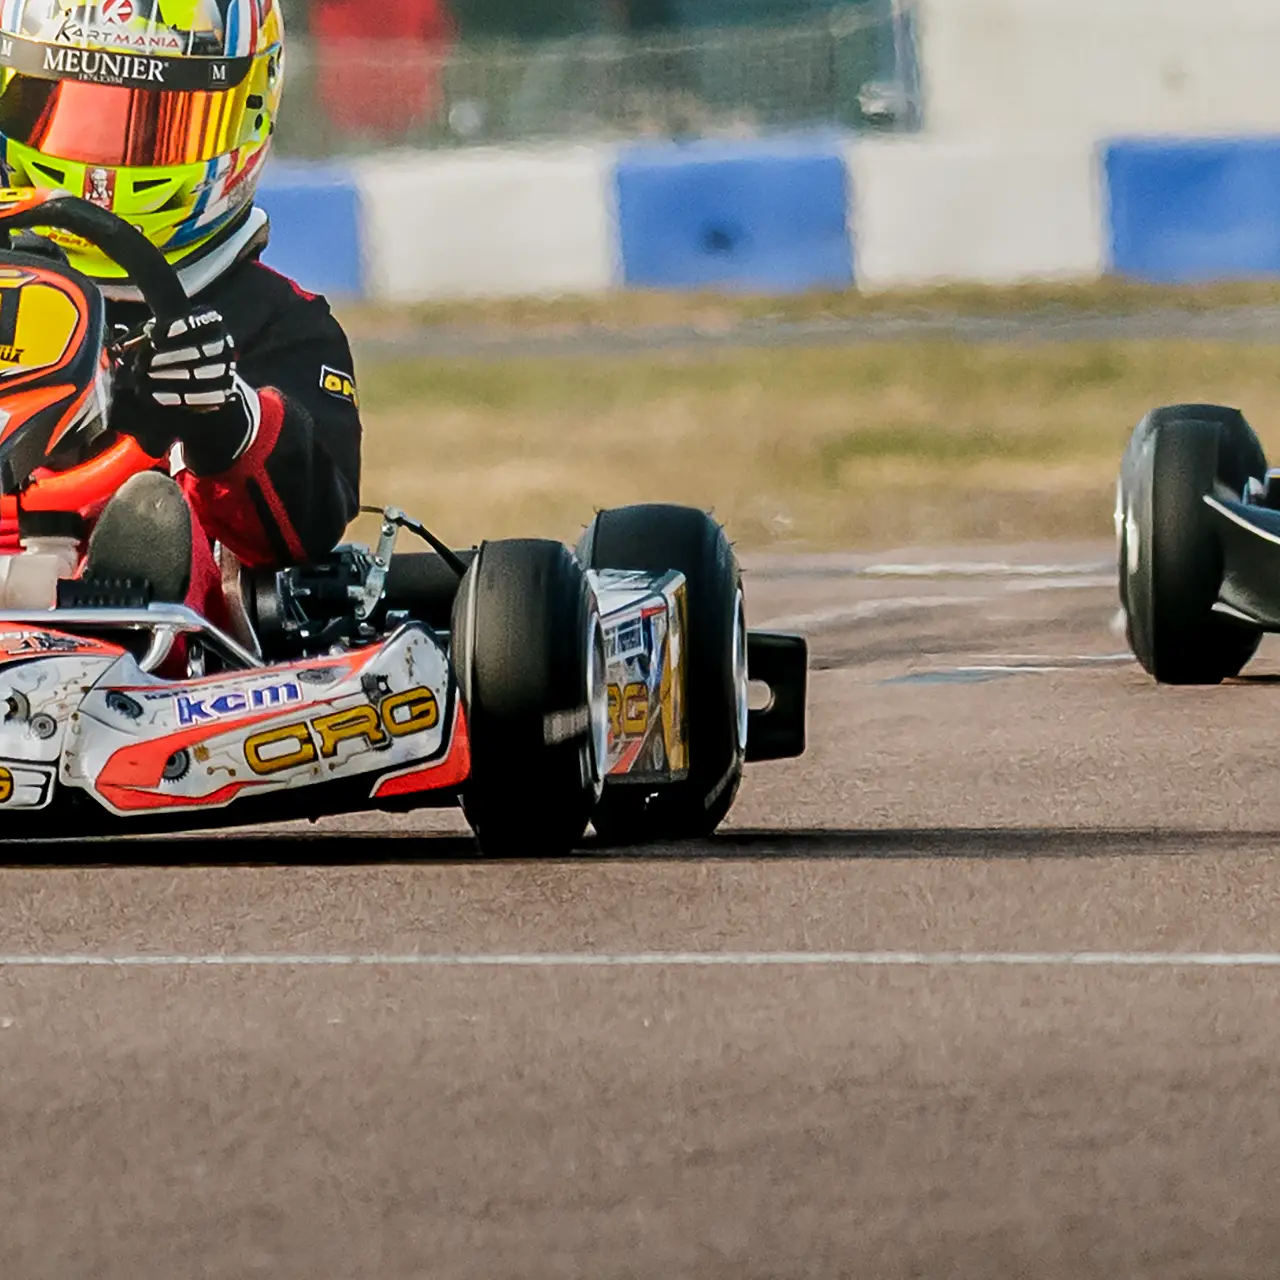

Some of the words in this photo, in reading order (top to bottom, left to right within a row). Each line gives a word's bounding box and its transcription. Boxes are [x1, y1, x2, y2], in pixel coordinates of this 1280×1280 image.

[0, 40, 13, 57] M
[43, 47, 164, 83] MEUNIER
[212, 64, 225, 81] M
[175, 680, 304, 726] kcm
[243, 685, 439, 775] CRG
